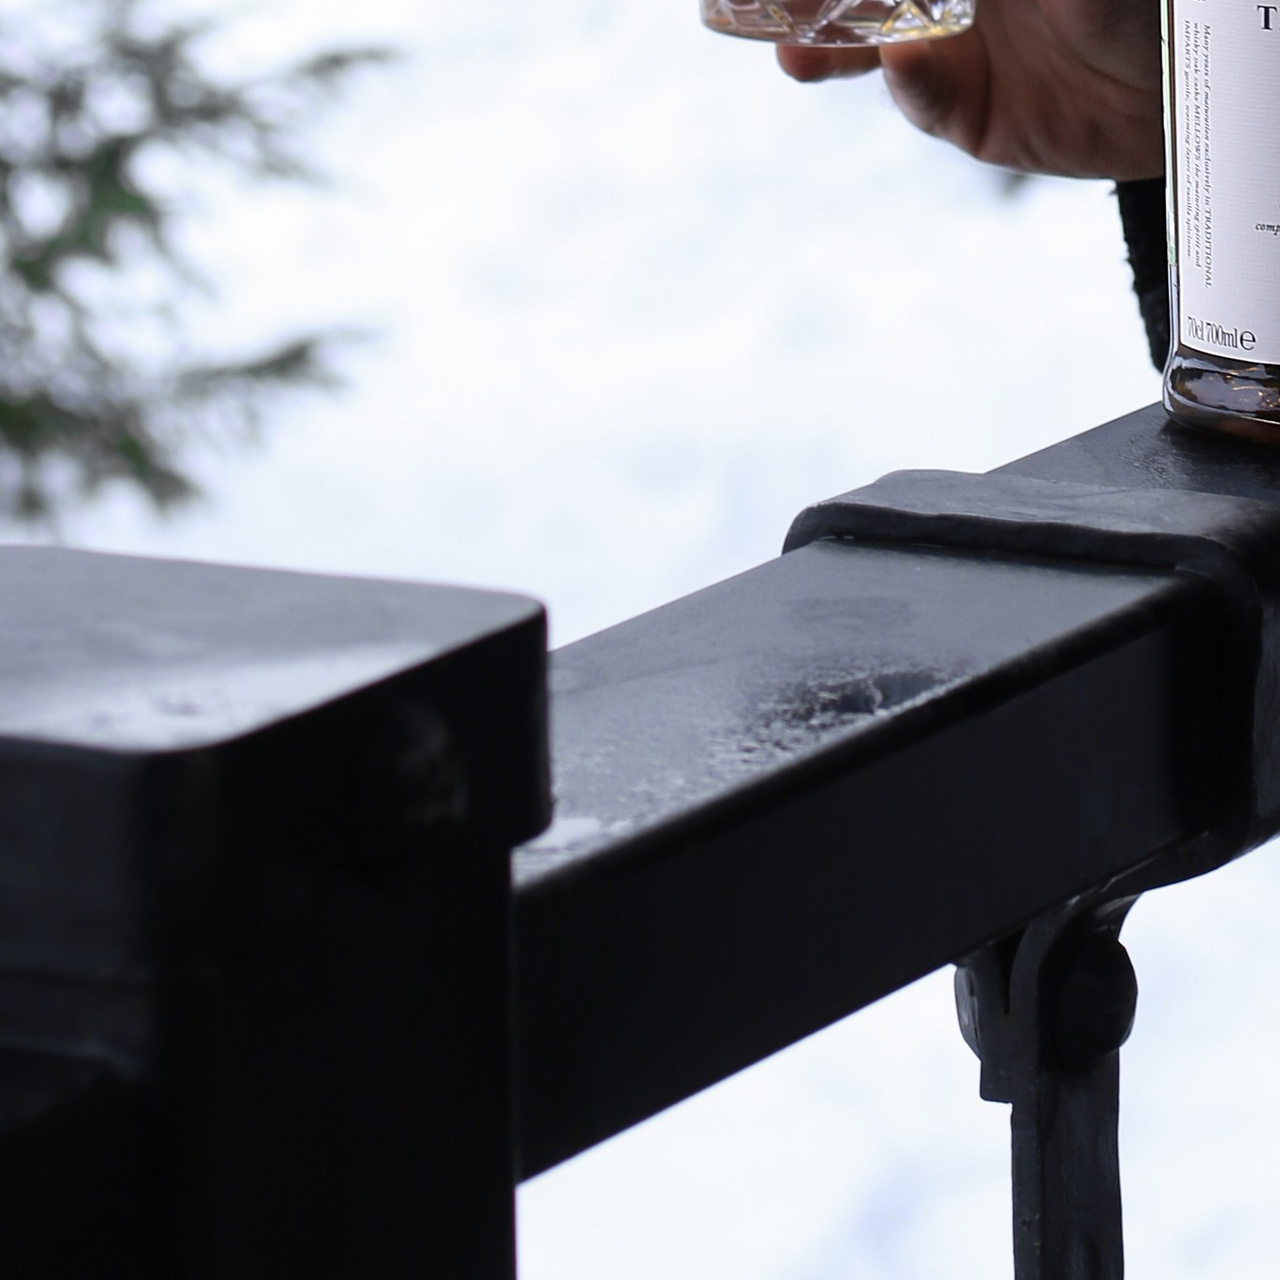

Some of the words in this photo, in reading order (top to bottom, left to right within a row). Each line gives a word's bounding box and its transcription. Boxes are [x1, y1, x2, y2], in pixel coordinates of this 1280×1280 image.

[1204, 79, 1211, 90] of
[1204, 208, 1212, 288] TRADITIONAL
[1206, 322, 1238, 348] 700ml
